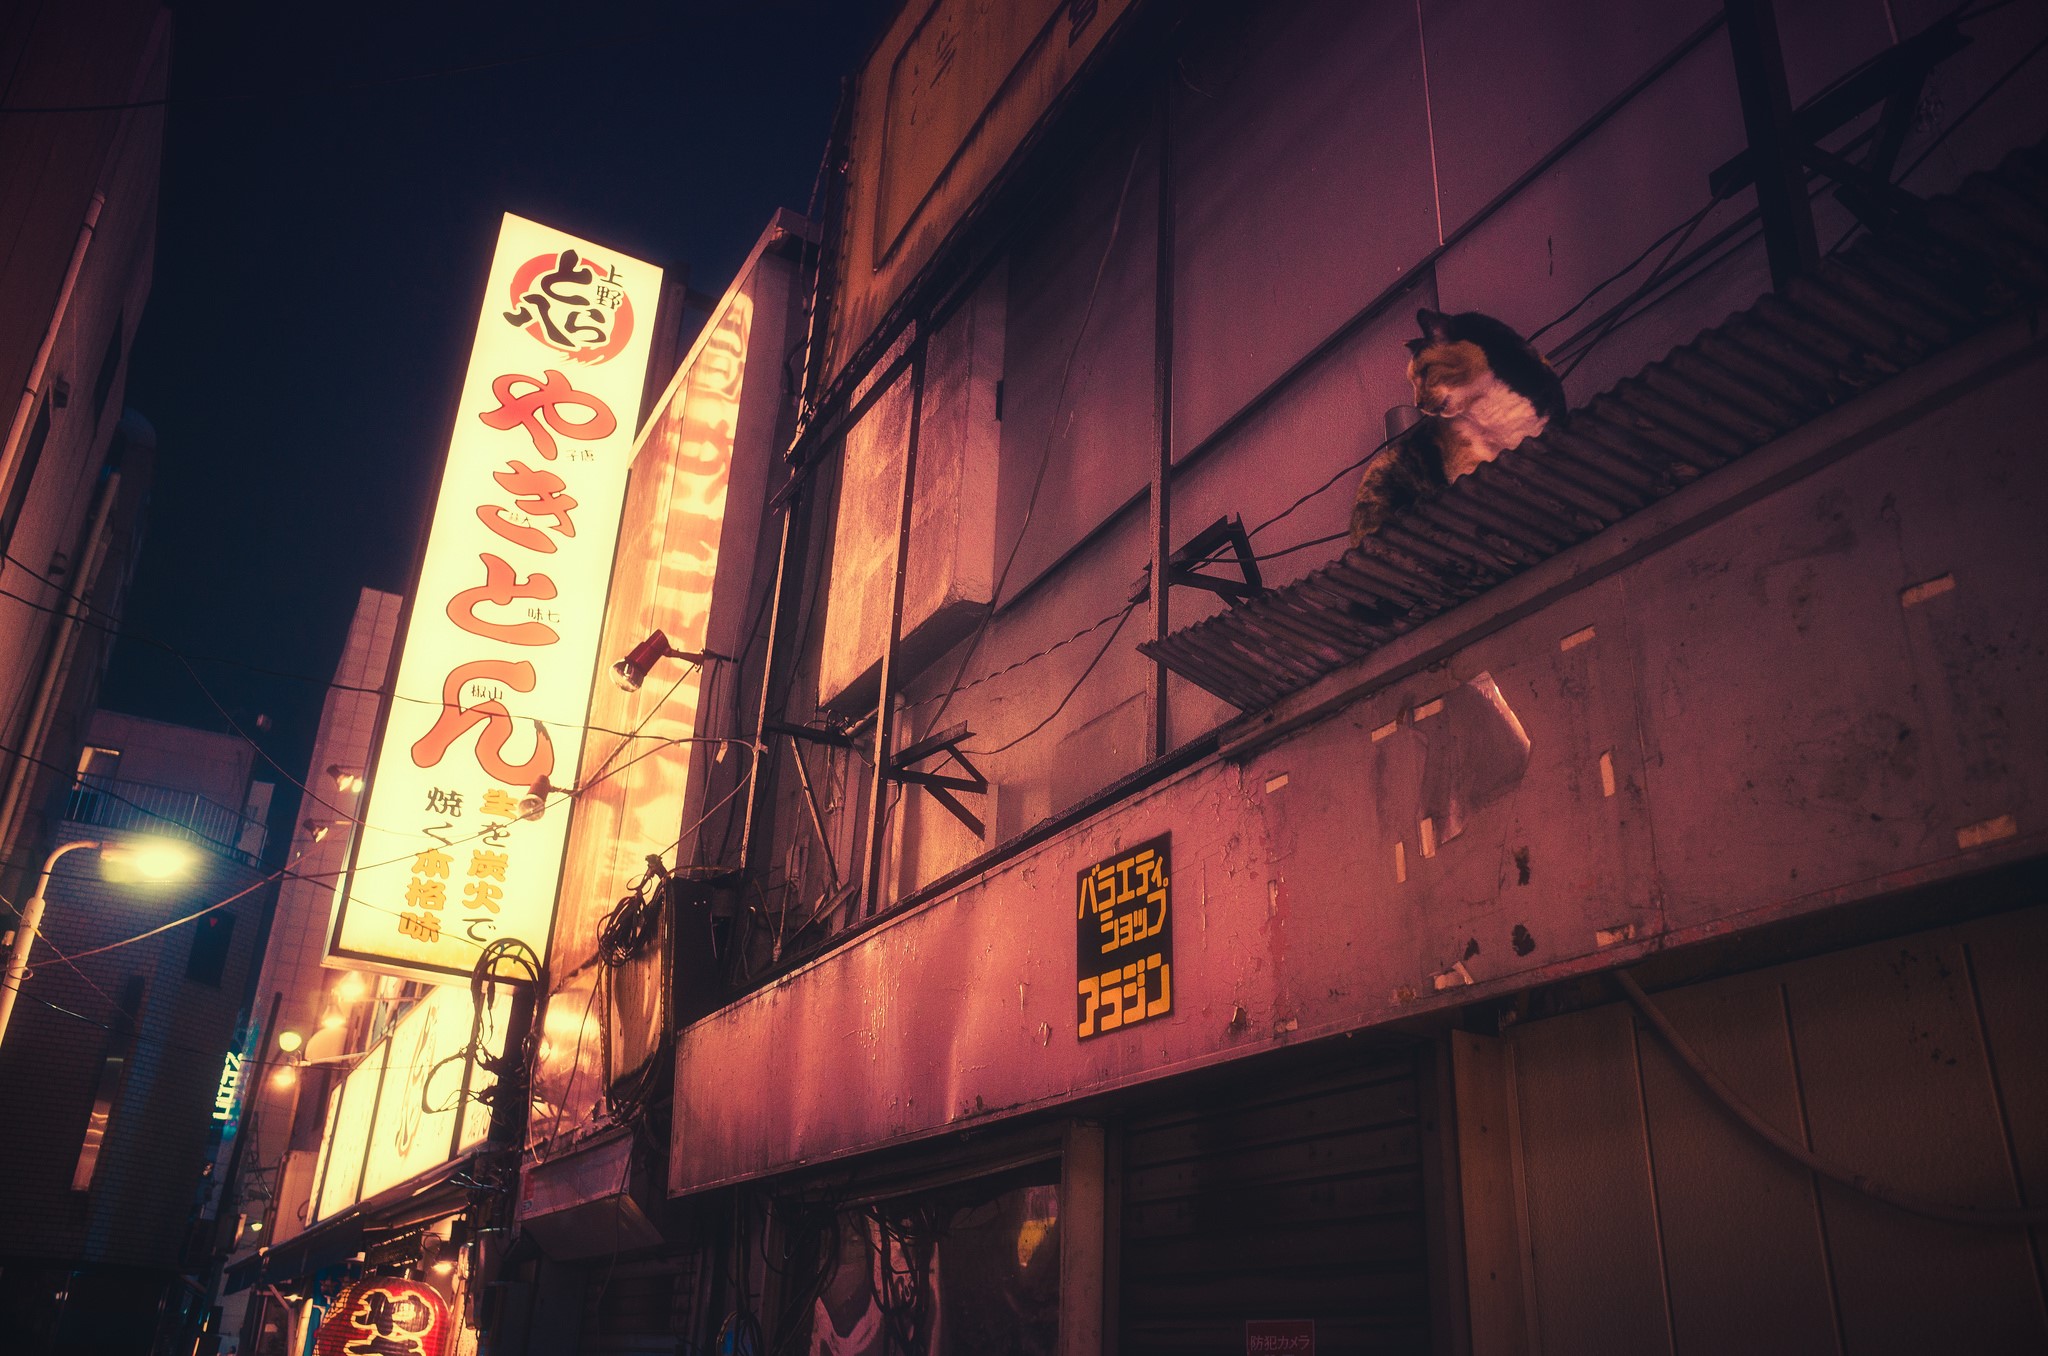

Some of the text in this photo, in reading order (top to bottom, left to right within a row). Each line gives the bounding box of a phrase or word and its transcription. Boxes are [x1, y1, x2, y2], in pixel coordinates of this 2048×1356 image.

[596, 263, 624, 310] 上野
[411, 368, 618, 786] やきとん
[397, 786, 464, 943] 焼く本格味
[462, 788, 519, 943] 生を炭火で
[1078, 848, 1164, 920] バラエティ
[1100, 876, 1169, 954] ショップ
[1078, 952, 1170, 1038] アラジン
[1250, 1335, 1311, 1351] 防犯カメラ
